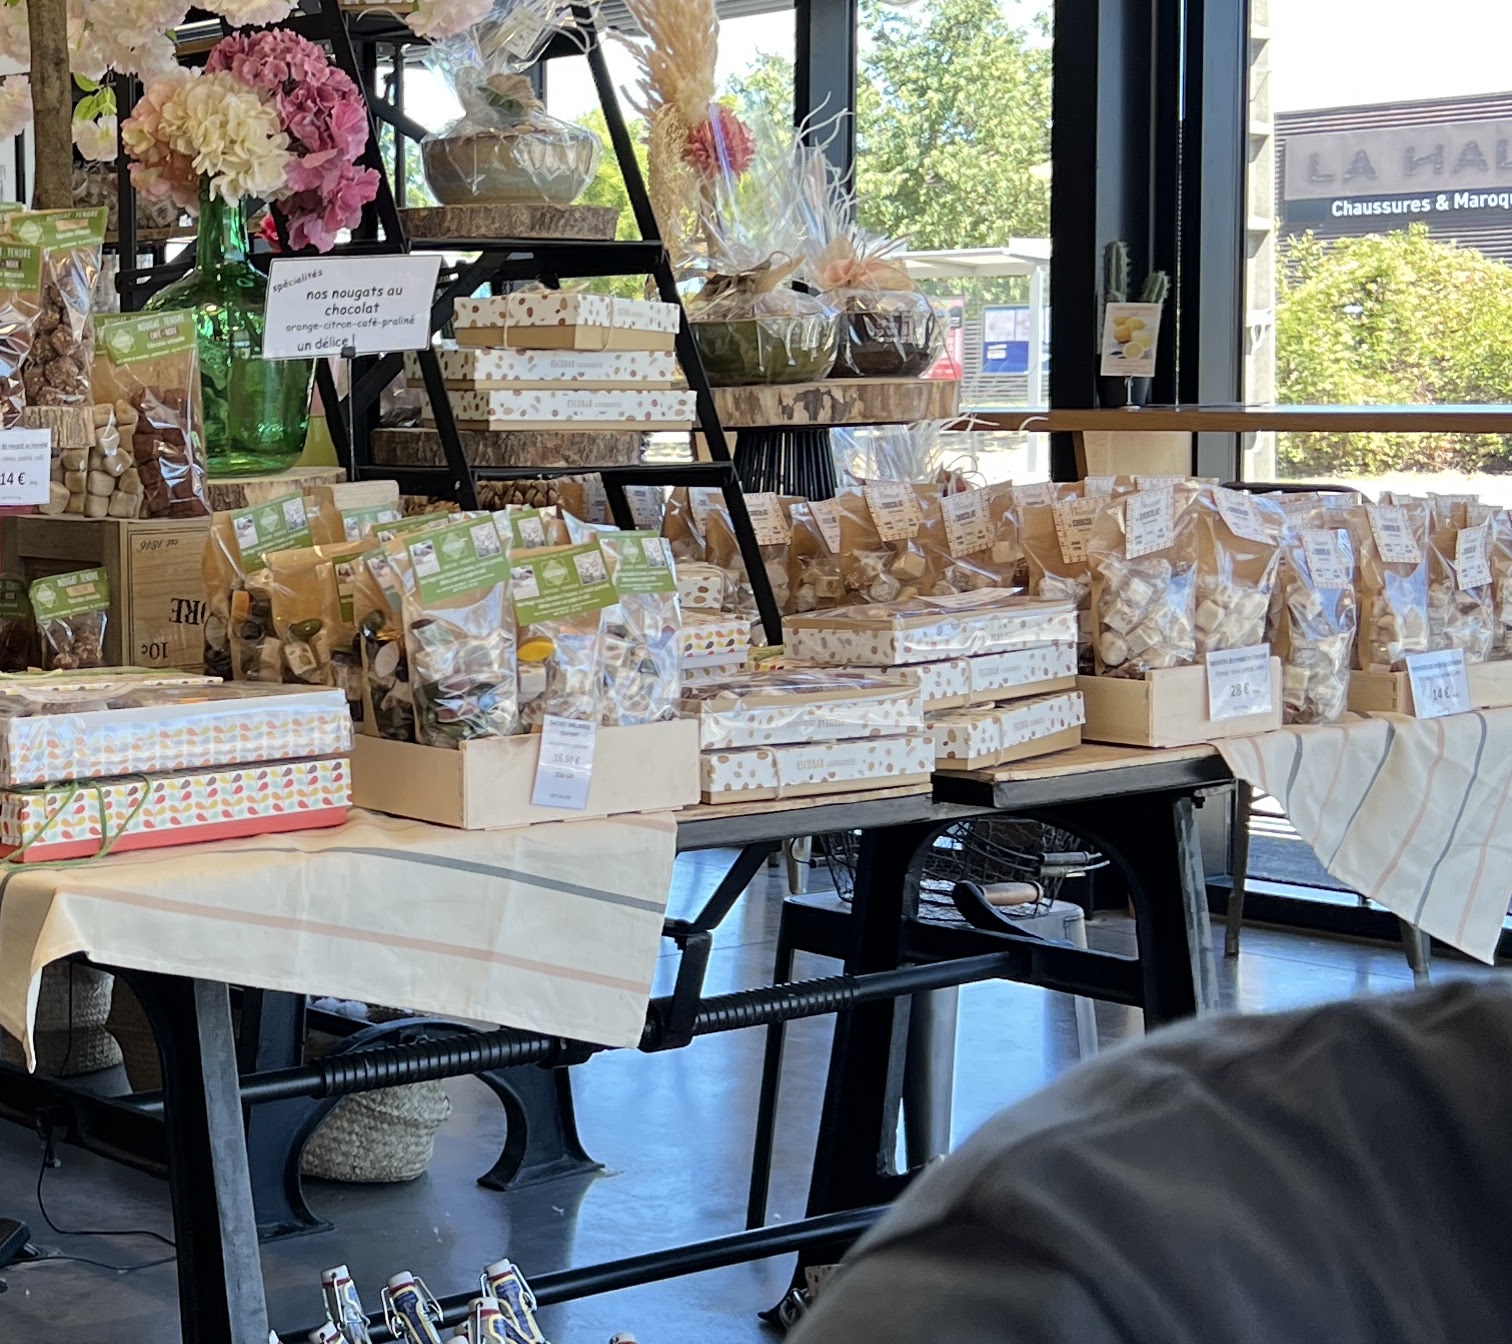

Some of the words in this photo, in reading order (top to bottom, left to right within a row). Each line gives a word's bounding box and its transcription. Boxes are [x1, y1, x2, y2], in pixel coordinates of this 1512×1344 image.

[1307, 148, 1378, 184] LA
[1332, 196, 1432, 217] Chaussures
[1436, 194, 1449, 211] &
[272, 268, 324, 293] spécialités
[306, 291, 328, 301] nos
[331, 285, 384, 301] nougats
[386, 286, 404, 296] au
[324, 302, 380, 317] chocolat
[297, 340, 312, 352] un
[316, 335, 349, 350] délice
[0, 472, 14, 486] 14
[17, 471, 26, 486] €
[1231, 683, 1242, 697] 28
[1244, 681, 1250, 695] €
